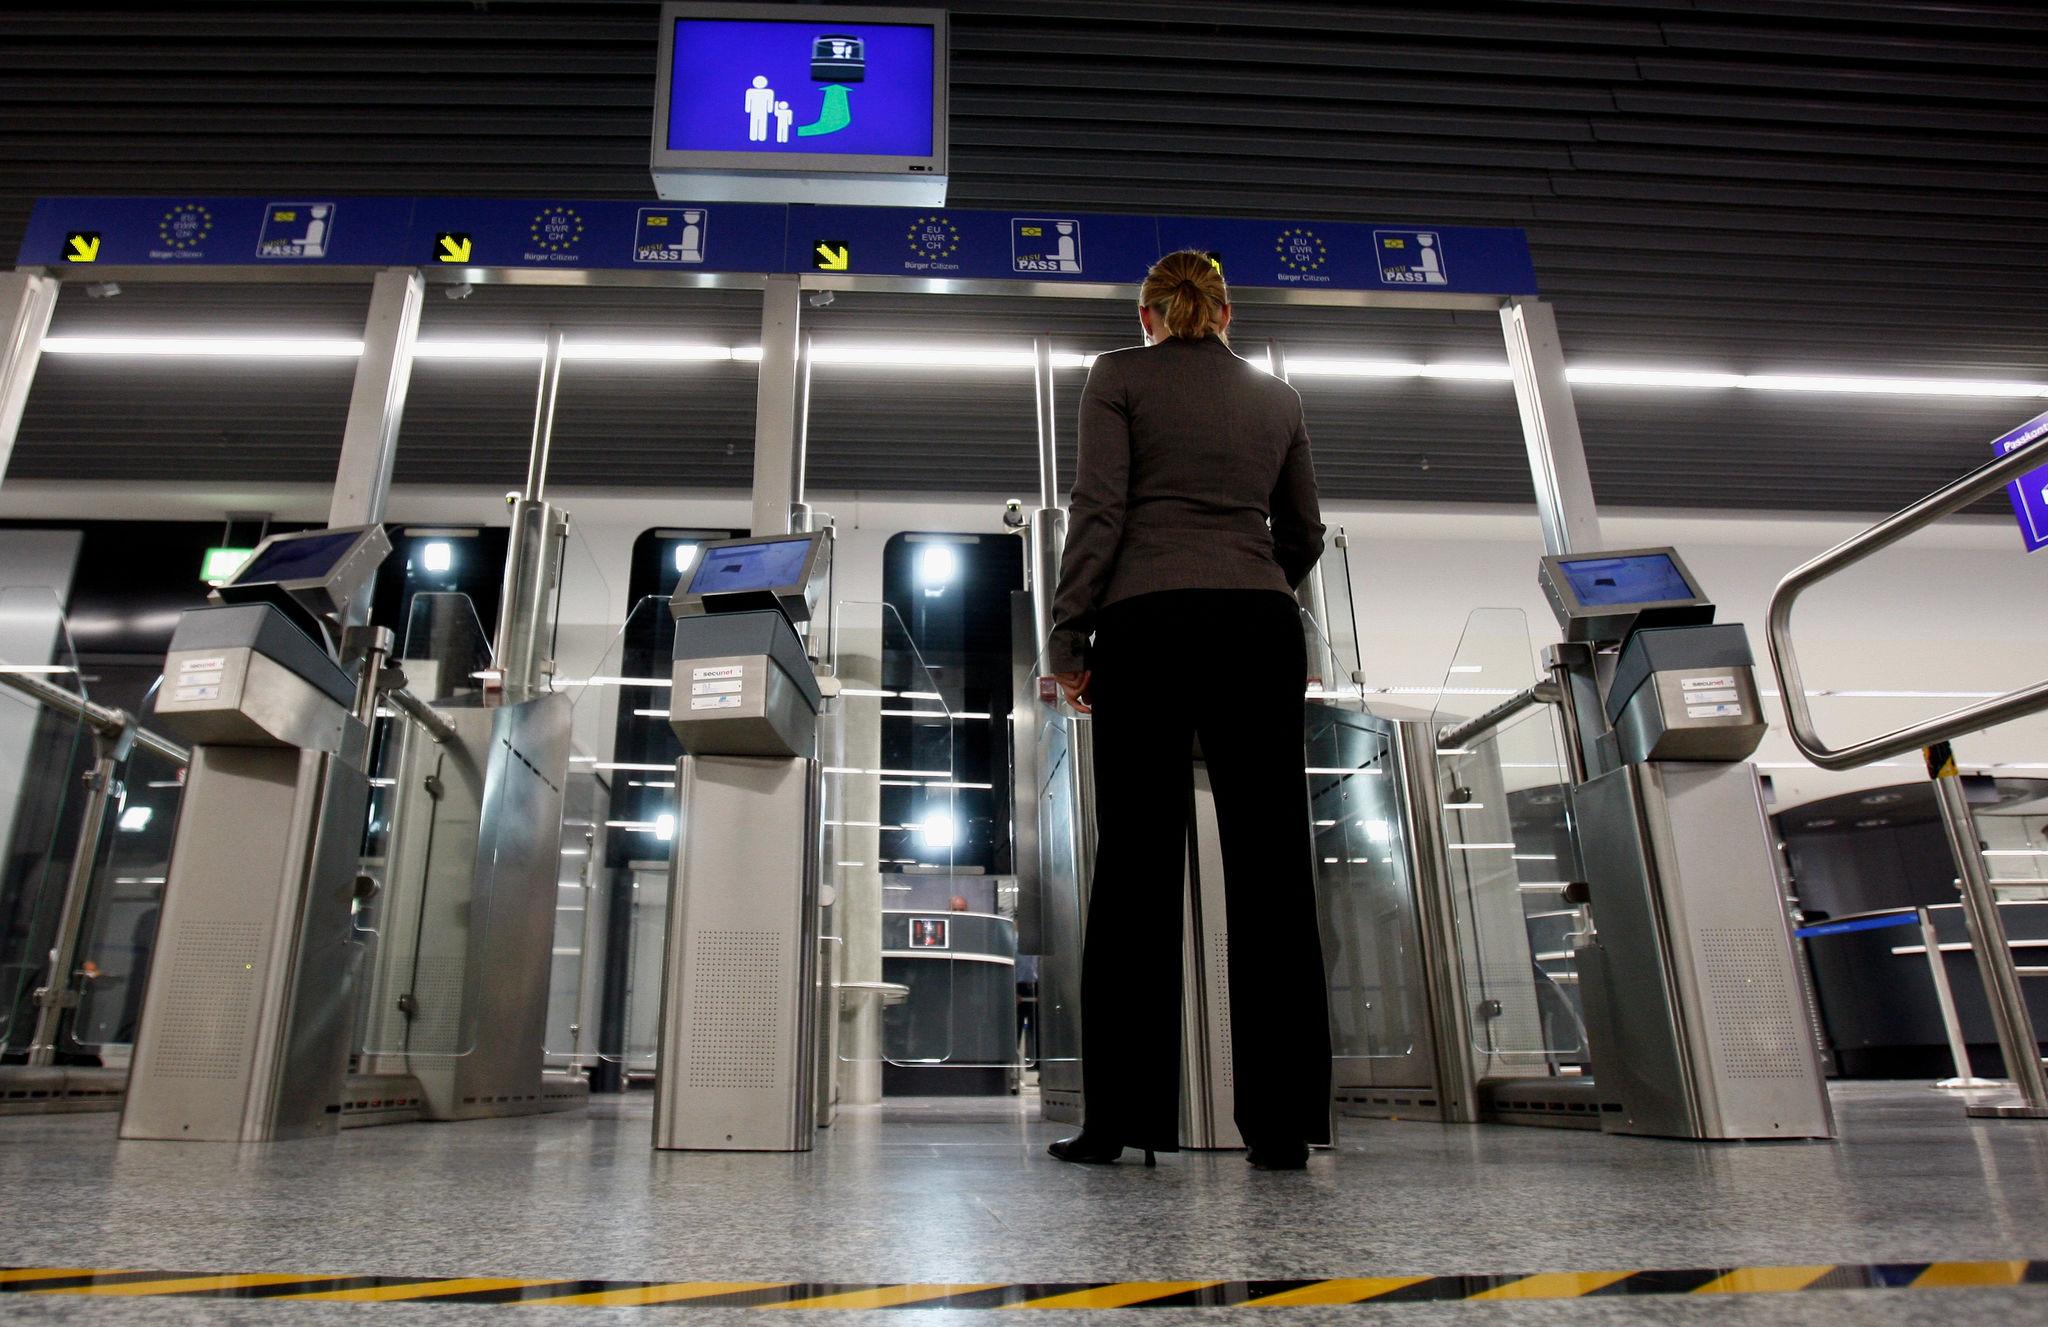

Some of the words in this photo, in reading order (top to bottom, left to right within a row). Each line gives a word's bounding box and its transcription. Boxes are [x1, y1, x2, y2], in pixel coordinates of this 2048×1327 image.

[551, 216, 566, 224] EU
[545, 224, 569, 232] EWR
[926, 225, 941, 233] EU
[921, 233, 945, 241] EWR
[926, 241, 941, 249] CH
[1293, 238, 1307, 246] EU
[262, 245, 302, 256] PASS
[1289, 246, 1313, 254] EWR
[639, 251, 679, 260] PASS
[1019, 260, 1058, 270] PASS
[1386, 272, 1424, 282] PASS
[703, 669, 733, 677] secunet
